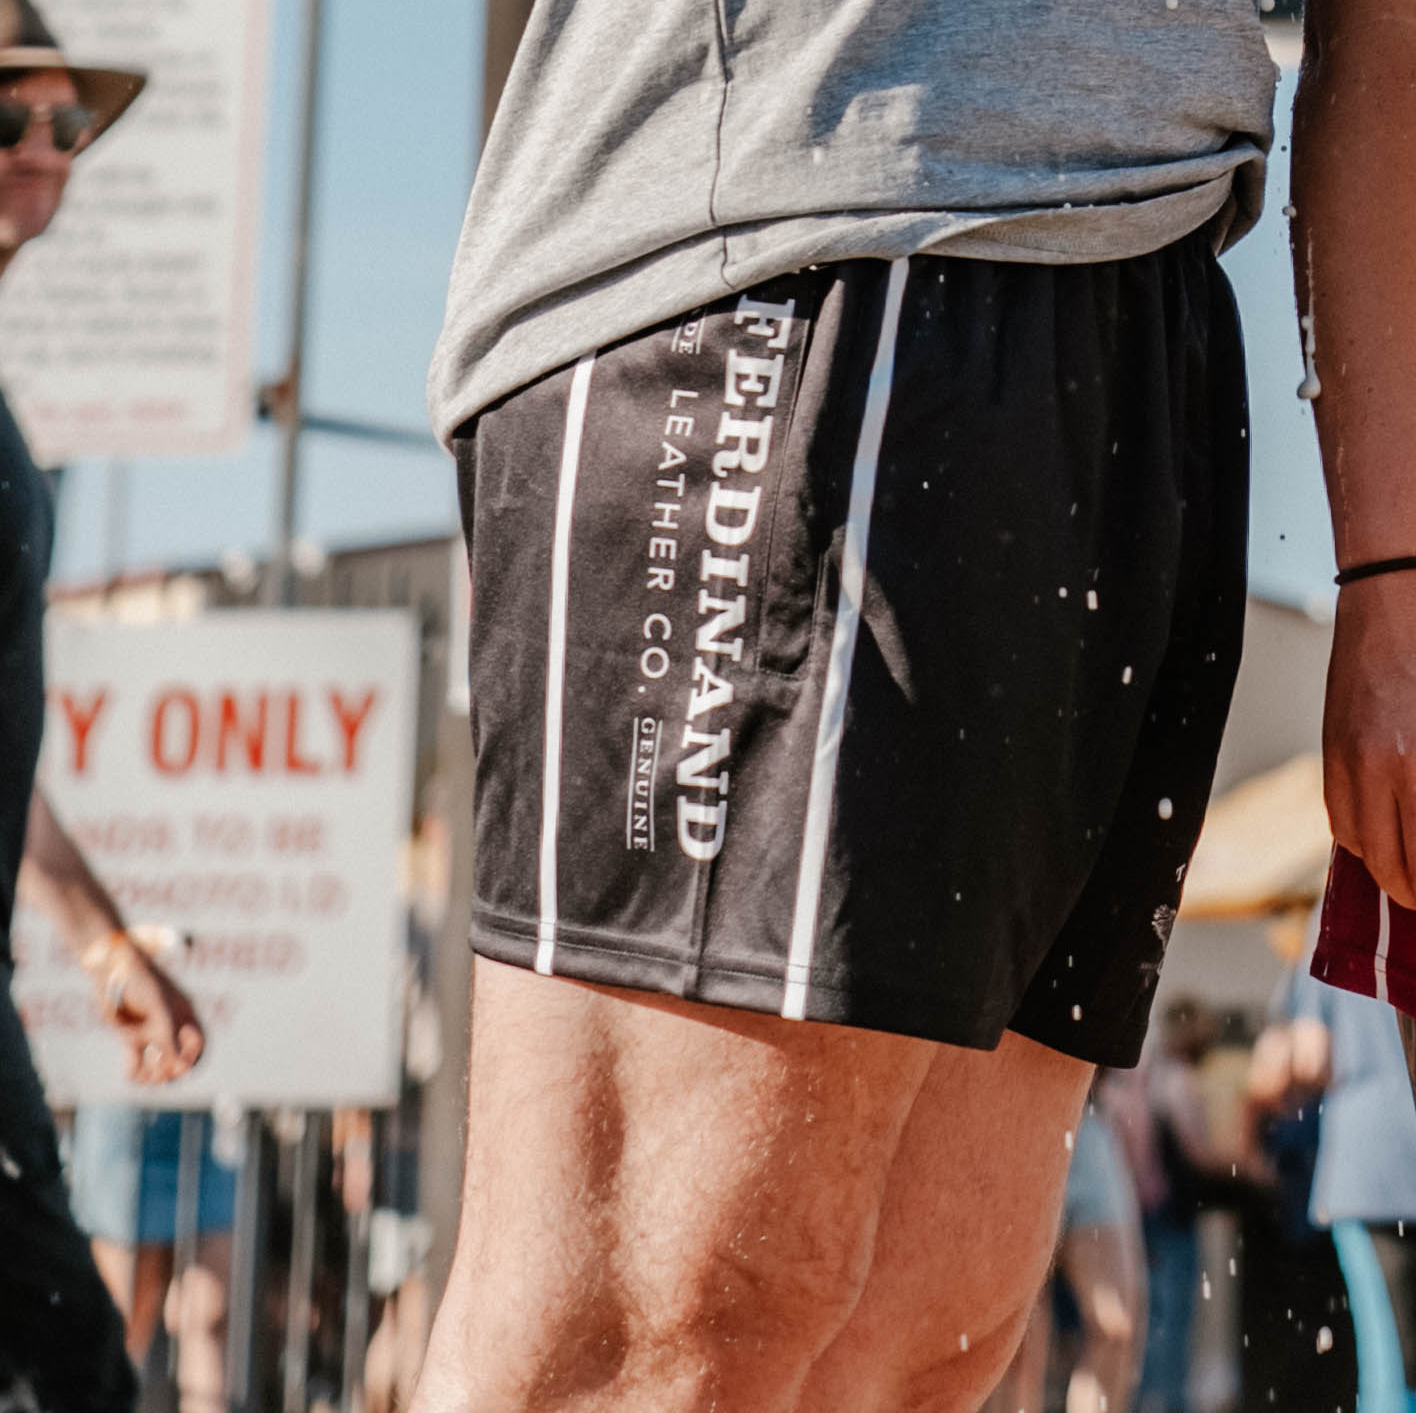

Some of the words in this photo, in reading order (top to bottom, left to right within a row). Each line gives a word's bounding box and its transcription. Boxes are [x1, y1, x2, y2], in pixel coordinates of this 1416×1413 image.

[646, 388, 699, 592] LEATHER
[675, 293, 796, 863] FERDINAND
[637, 612, 673, 694] CO.
[146, 683, 382, 781] ONLY
[632, 716, 656, 851] GENUINE
